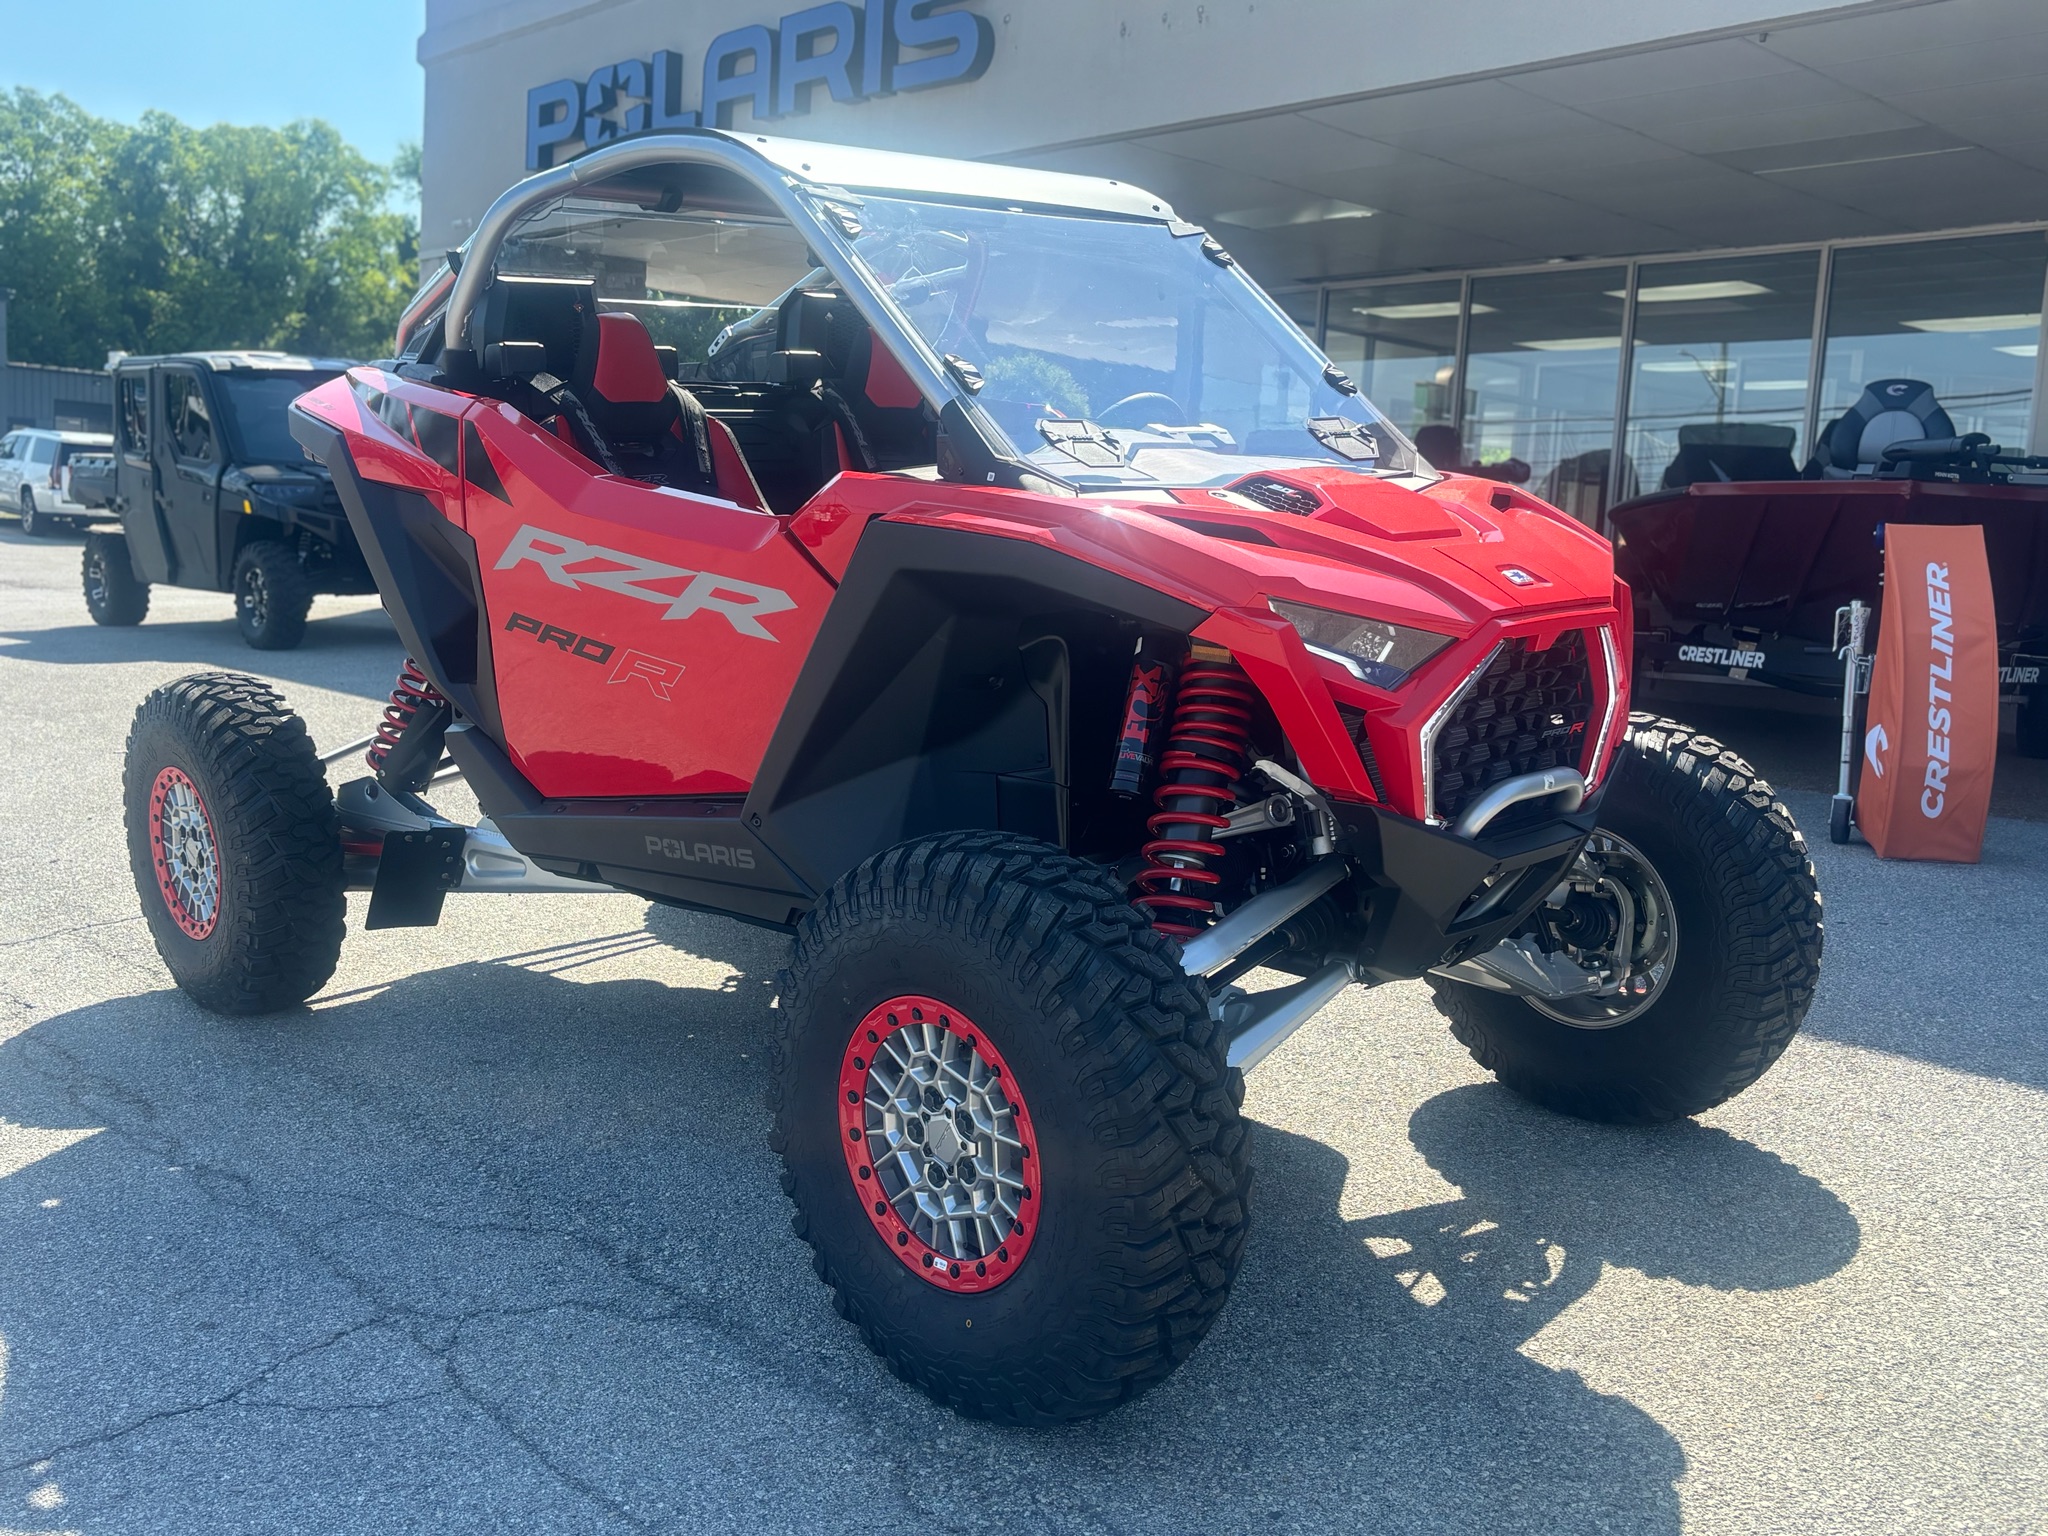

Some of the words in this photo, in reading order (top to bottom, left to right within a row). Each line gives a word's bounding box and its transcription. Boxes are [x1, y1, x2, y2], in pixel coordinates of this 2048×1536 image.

[526, 0, 990, 170] POLARIS
[633, 474, 670, 484] ZR
[493, 524, 798, 643] RZR
[504, 612, 616, 665] PRO
[607, 648, 686, 701] R
[1678, 645, 1765, 669] CRESTLINER
[1920, 562, 1955, 819] CRESTLINER
[1998, 667, 2040, 683] TLINER
[1120, 664, 1164, 744] FOX
[644, 836, 756, 869] POLARIS
